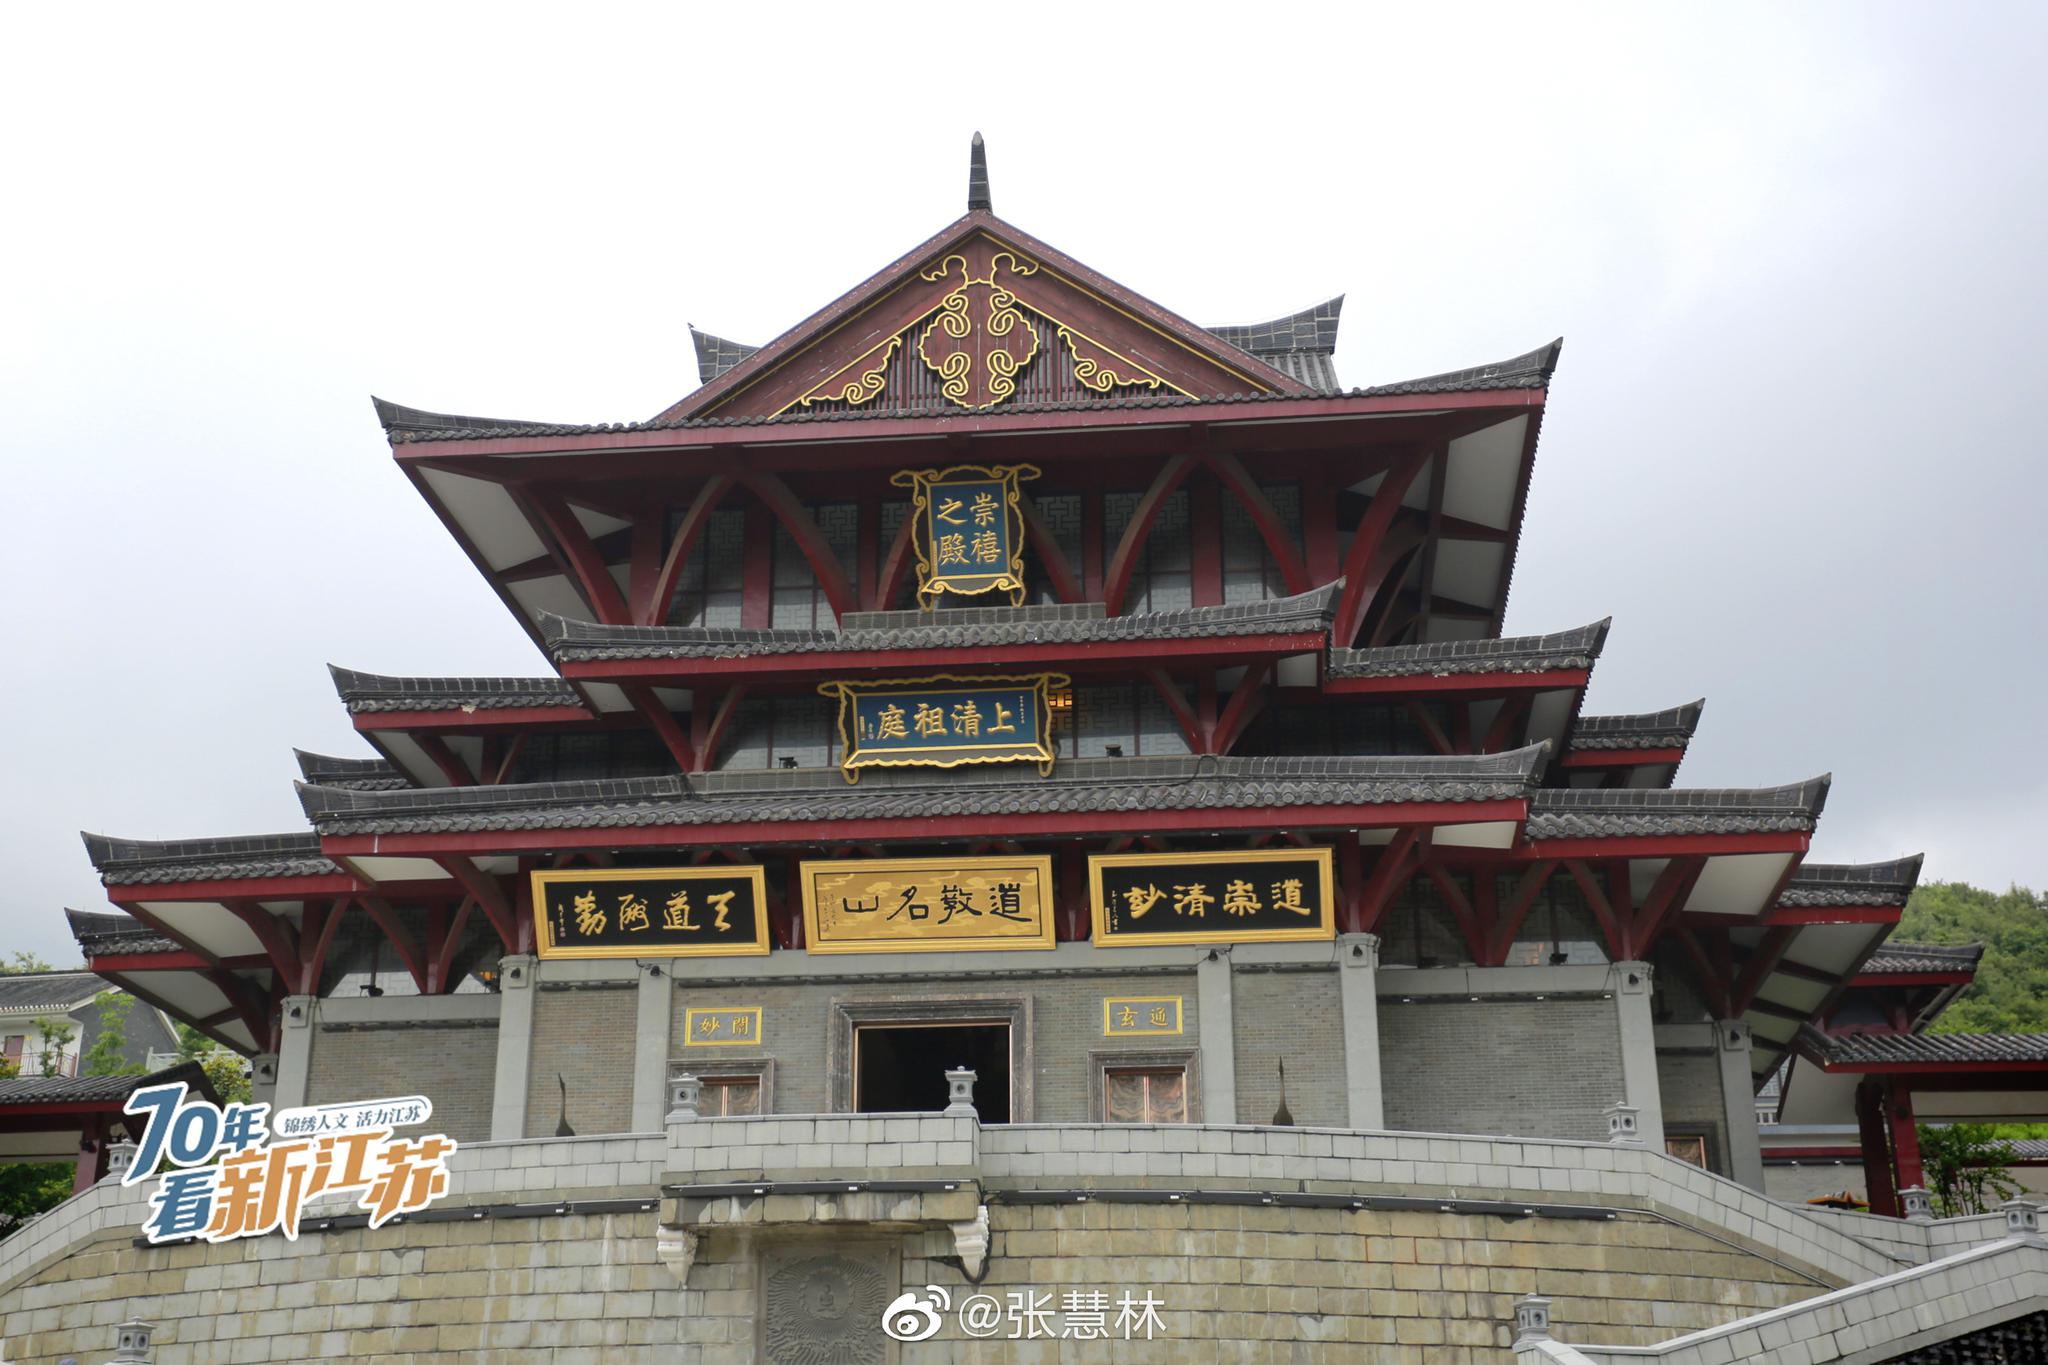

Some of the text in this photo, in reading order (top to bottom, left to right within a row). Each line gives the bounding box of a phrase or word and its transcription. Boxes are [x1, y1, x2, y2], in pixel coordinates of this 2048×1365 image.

[876, 700, 1016, 740] 上清祖庭
[842, 883, 1033, 925] 道教名山
